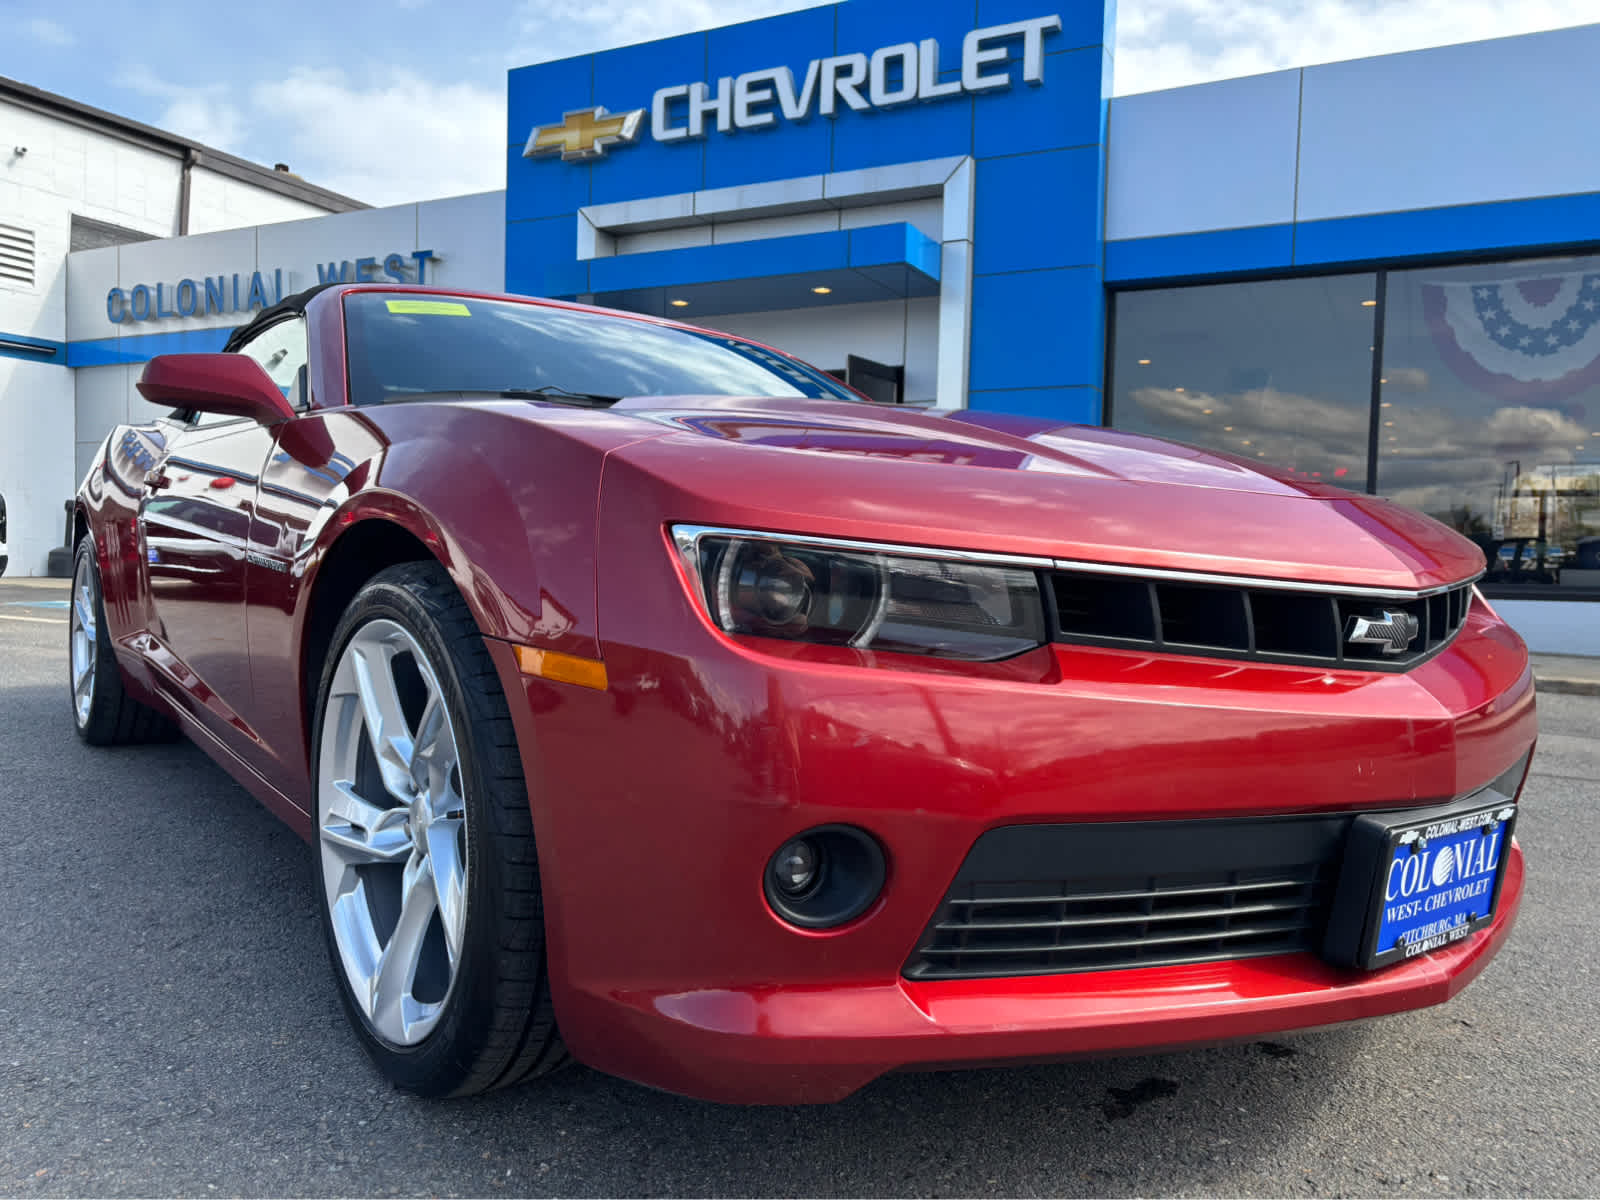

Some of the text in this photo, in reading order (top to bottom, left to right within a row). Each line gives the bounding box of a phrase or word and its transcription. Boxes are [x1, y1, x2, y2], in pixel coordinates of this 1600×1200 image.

[650, 14, 1062, 142] CHEVROLET
[106, 250, 433, 324] COLONIAL WEST
[1385, 833, 1499, 902] COLONIAL
[1424, 878, 1490, 912] CHEVROLET
[1406, 924, 1470, 958] COLONIAL WEST
